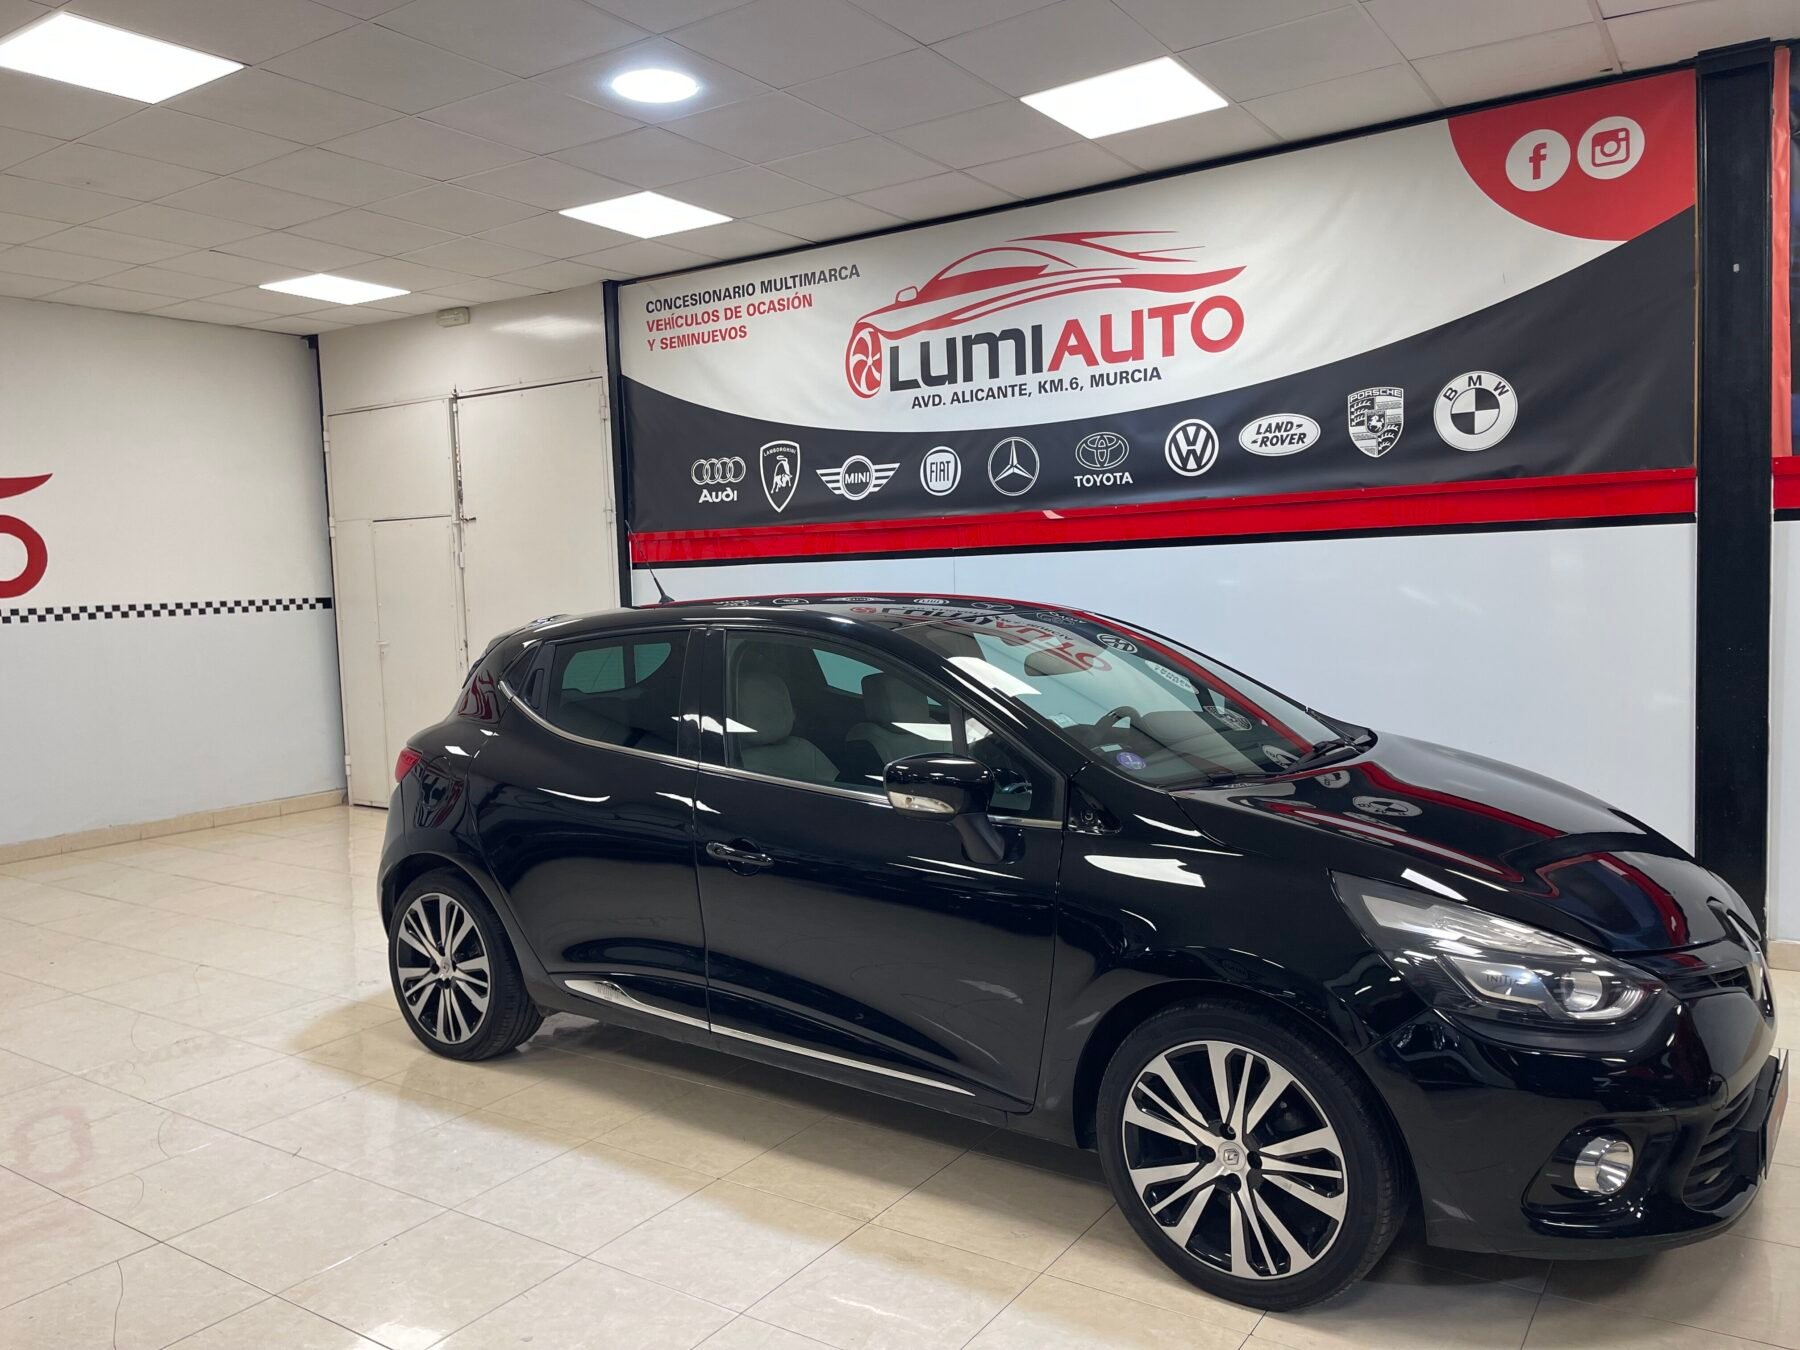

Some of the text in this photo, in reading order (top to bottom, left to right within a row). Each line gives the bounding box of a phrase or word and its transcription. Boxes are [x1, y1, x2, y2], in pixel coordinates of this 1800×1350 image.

[646, 264, 860, 313] CONCESIONARIO MULTIMARCA
[646, 292, 813, 333] VEHÍCULOS DE OCASIÓN
[647, 325, 747, 351] Y SEMINUEVOS
[911, 366, 1162, 410] AVD. ALICANTE, KM.6, MURCIA
[1350, 388, 1402, 401] PORSCHE
[1442, 374, 1510, 402] BMW
[1256, 420, 1296, 435] LAND
[1259, 433, 1307, 448] ROVER
[845, 471, 870, 485] MINI
[929, 460, 951, 483] FIAT
[1074, 472, 1133, 488] TOYOTA
[698, 487, 738, 503] Audi
